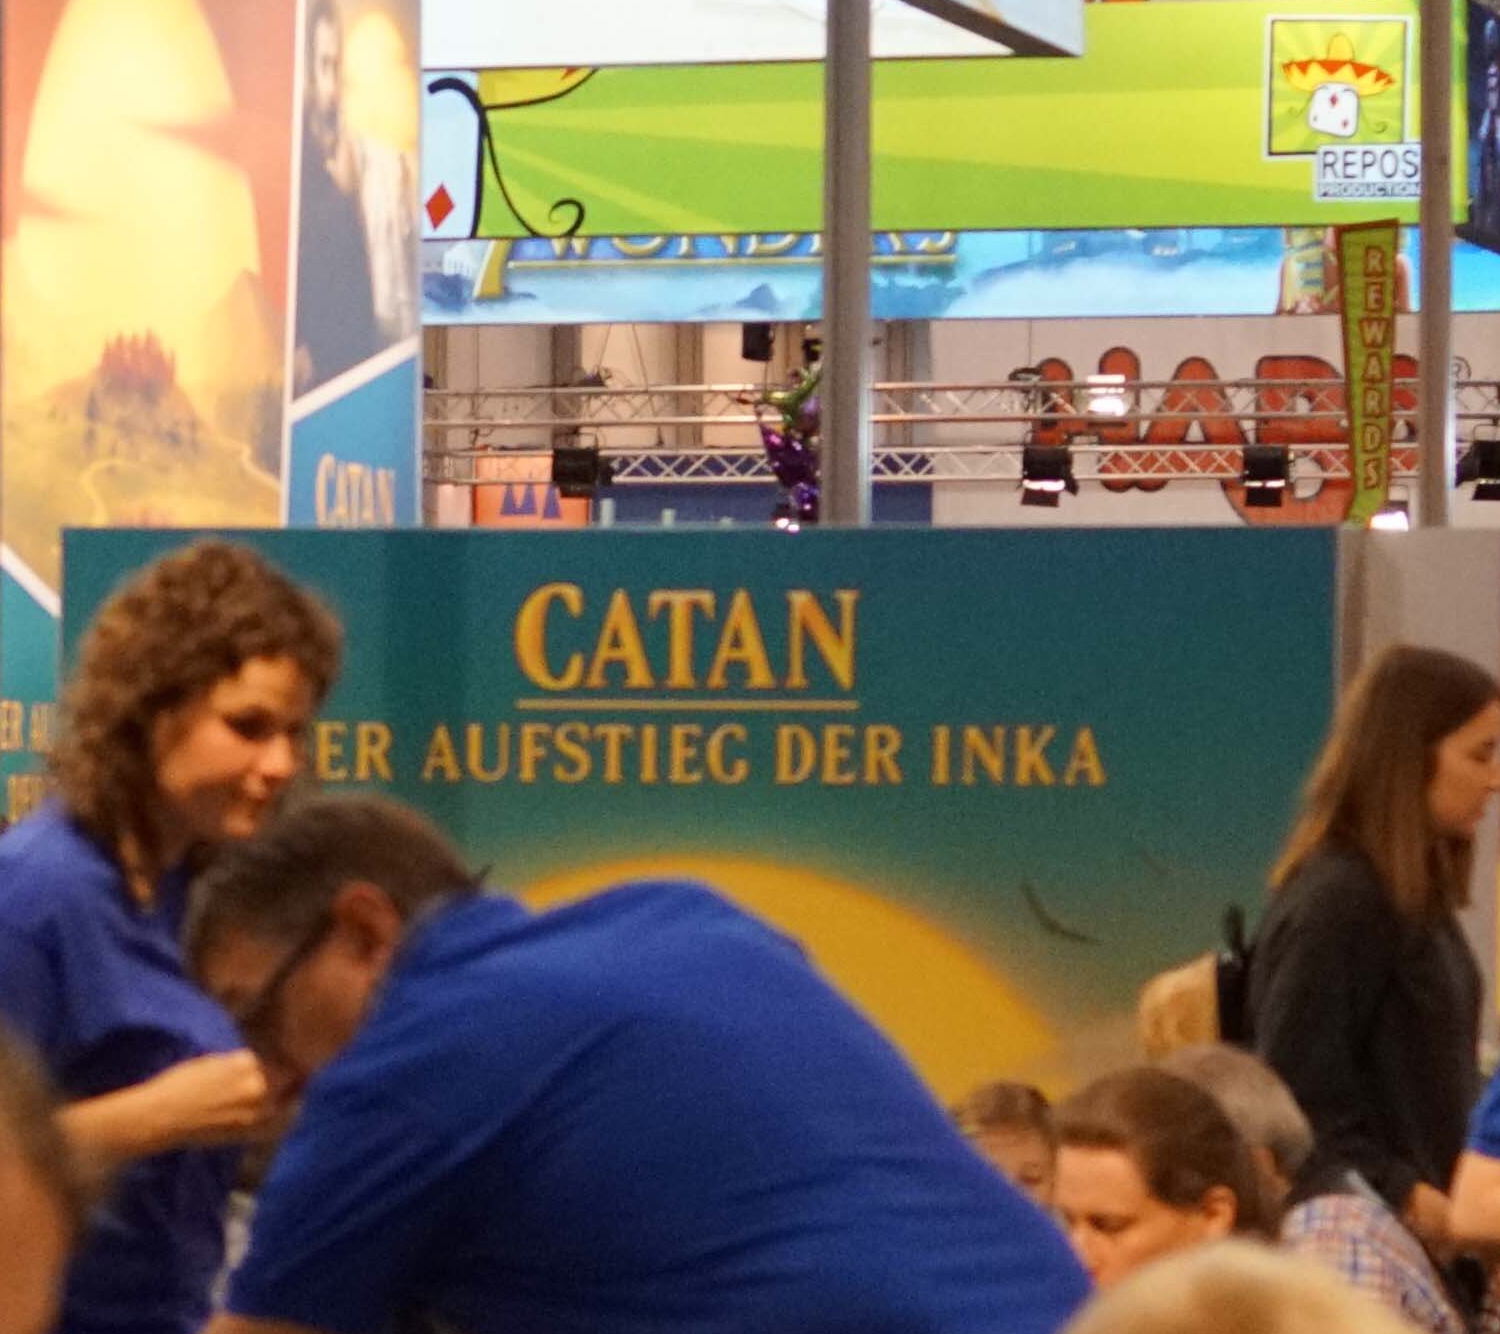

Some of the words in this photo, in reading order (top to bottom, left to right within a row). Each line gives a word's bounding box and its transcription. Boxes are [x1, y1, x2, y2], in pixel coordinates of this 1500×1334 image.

[1322, 149, 1420, 180] REPOS
[1359, 244, 1394, 490] REWARDS
[314, 453, 397, 527] CATAN
[512, 580, 861, 694] CATAN
[422, 719, 752, 785] AUFSTIEG
[775, 722, 907, 786] DER
[930, 724, 1108, 787] INKA
